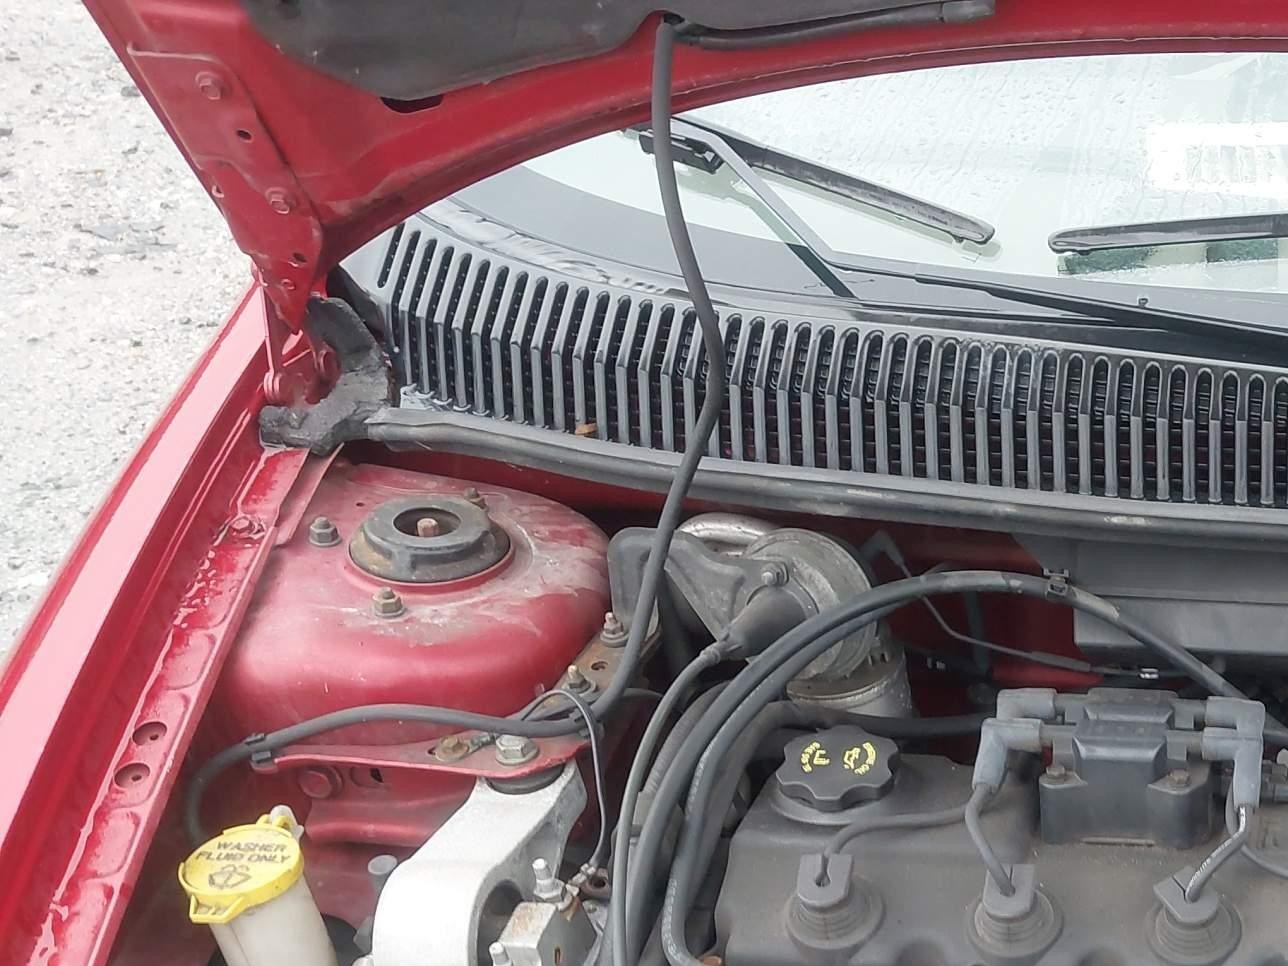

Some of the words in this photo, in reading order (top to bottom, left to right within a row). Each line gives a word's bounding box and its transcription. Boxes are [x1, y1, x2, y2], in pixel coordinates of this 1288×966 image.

[216, 841, 288, 853] WASHER
[196, 850, 244, 861] FLUID
[247, 854, 291, 864] ONLY
